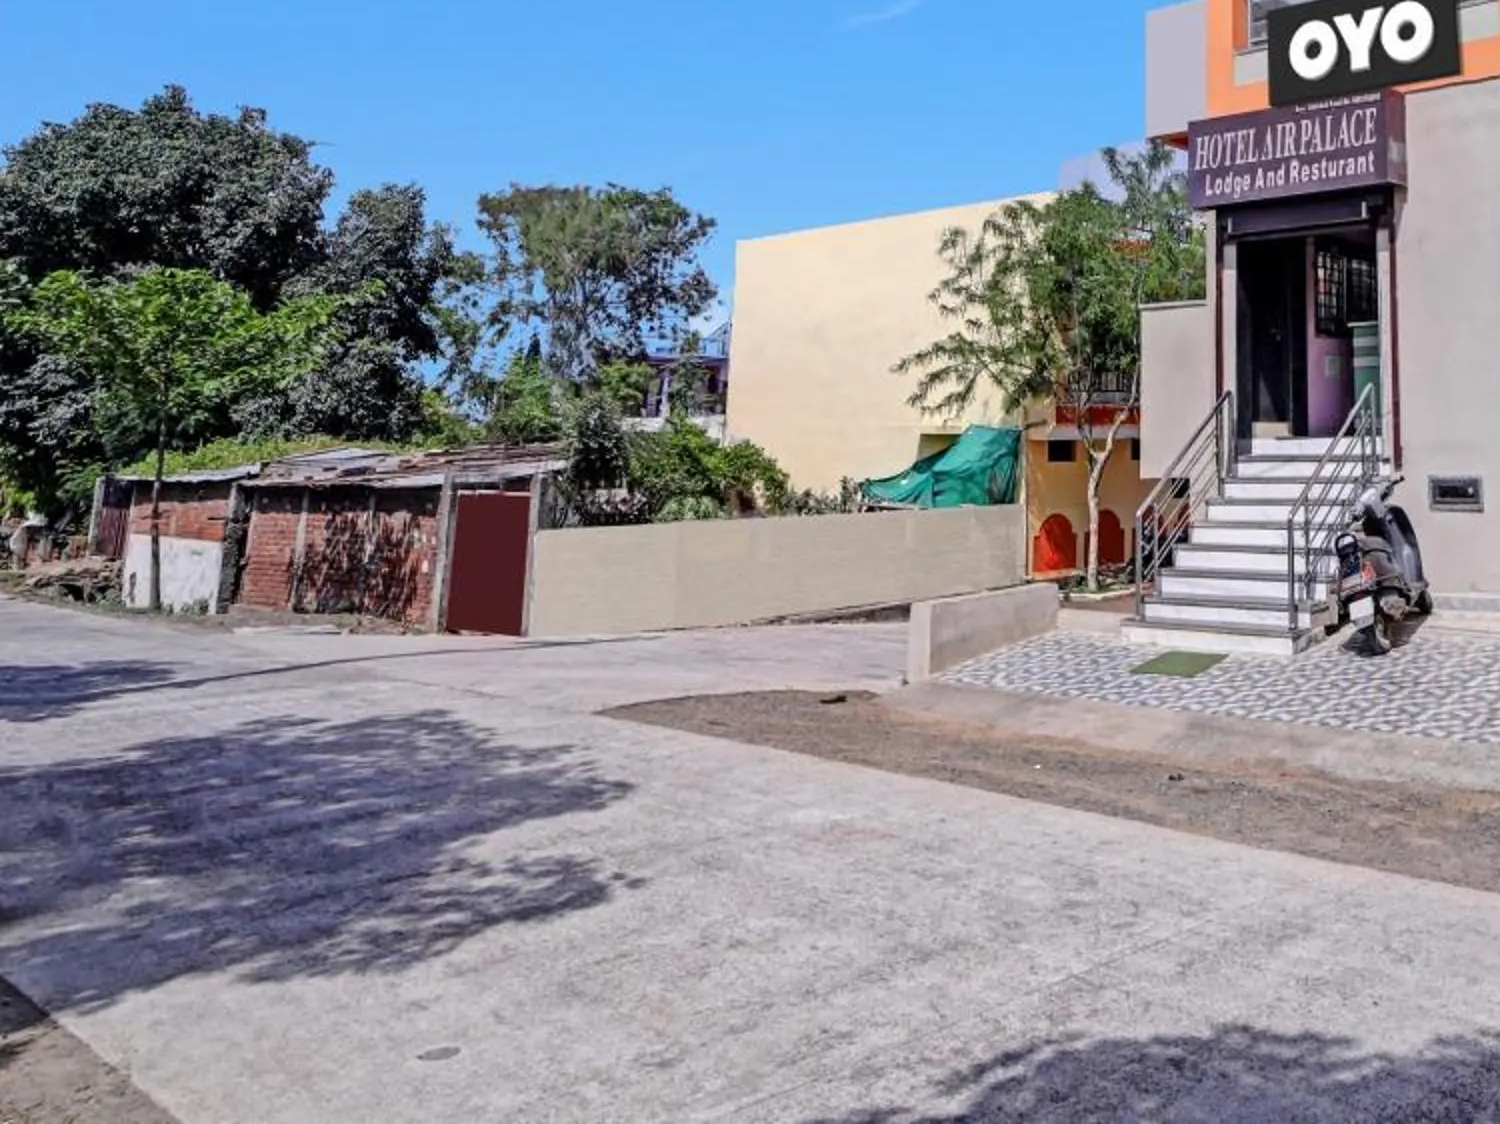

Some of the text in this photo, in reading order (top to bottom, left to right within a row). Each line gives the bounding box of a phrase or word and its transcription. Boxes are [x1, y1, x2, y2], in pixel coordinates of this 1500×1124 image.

[1288, 0, 1435, 81] OYO
[1194, 107, 1377, 171] HOTEL AIR PALACE
[1205, 150, 1376, 198] Lodge And Resturant
